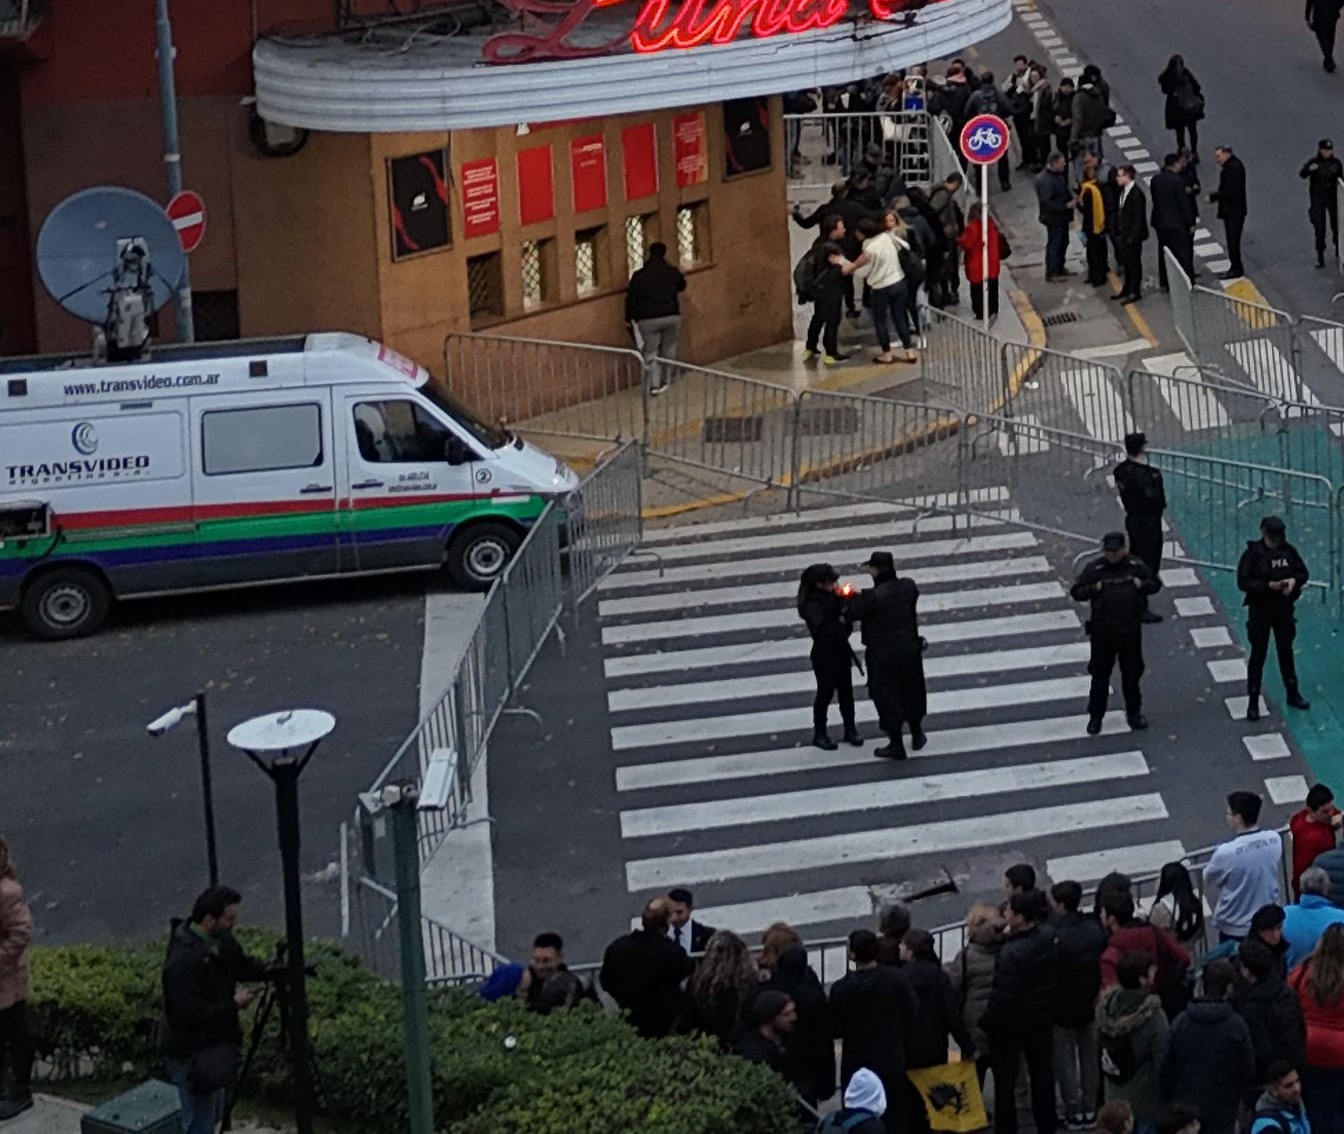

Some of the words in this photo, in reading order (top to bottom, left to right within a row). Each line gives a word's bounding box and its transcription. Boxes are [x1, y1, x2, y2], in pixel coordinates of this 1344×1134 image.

[63, 373, 221, 397] www.transvideo.com.ar
[8, 454, 150, 479] TRANSVIDEO
[1272, 558, 1289, 568] PFA
